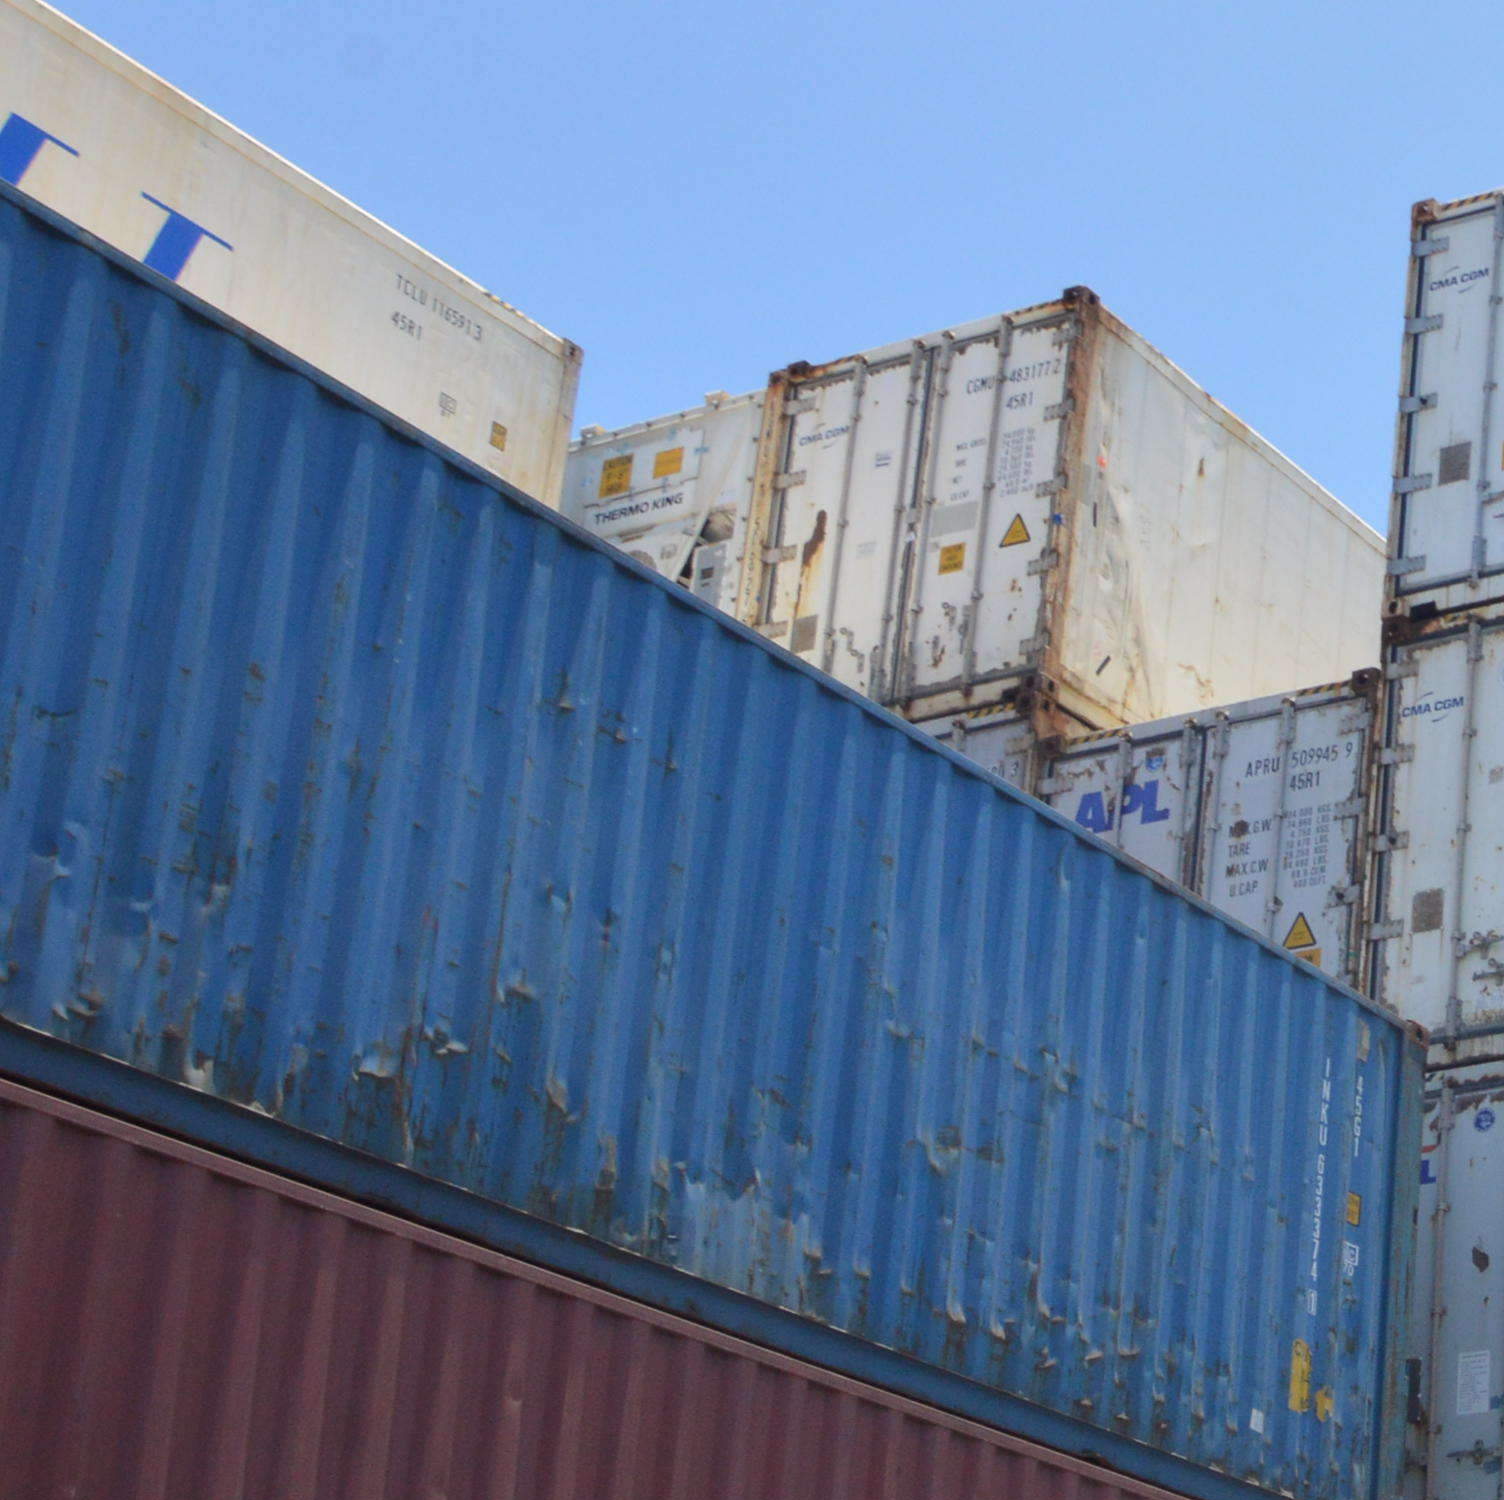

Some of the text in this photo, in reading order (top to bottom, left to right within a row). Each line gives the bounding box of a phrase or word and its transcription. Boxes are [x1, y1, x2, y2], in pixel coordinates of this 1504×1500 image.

[1429, 267, 1490, 292] CMA CGM
[594, 492, 684, 526] THERMO KING
[1401, 695, 1465, 718] CMA CGM
[1245, 757, 1280, 778] APRU
[1291, 745, 1338, 768] 509945
[1289, 771, 1320, 791] 45R1
[1075, 780, 1171, 834] APL
